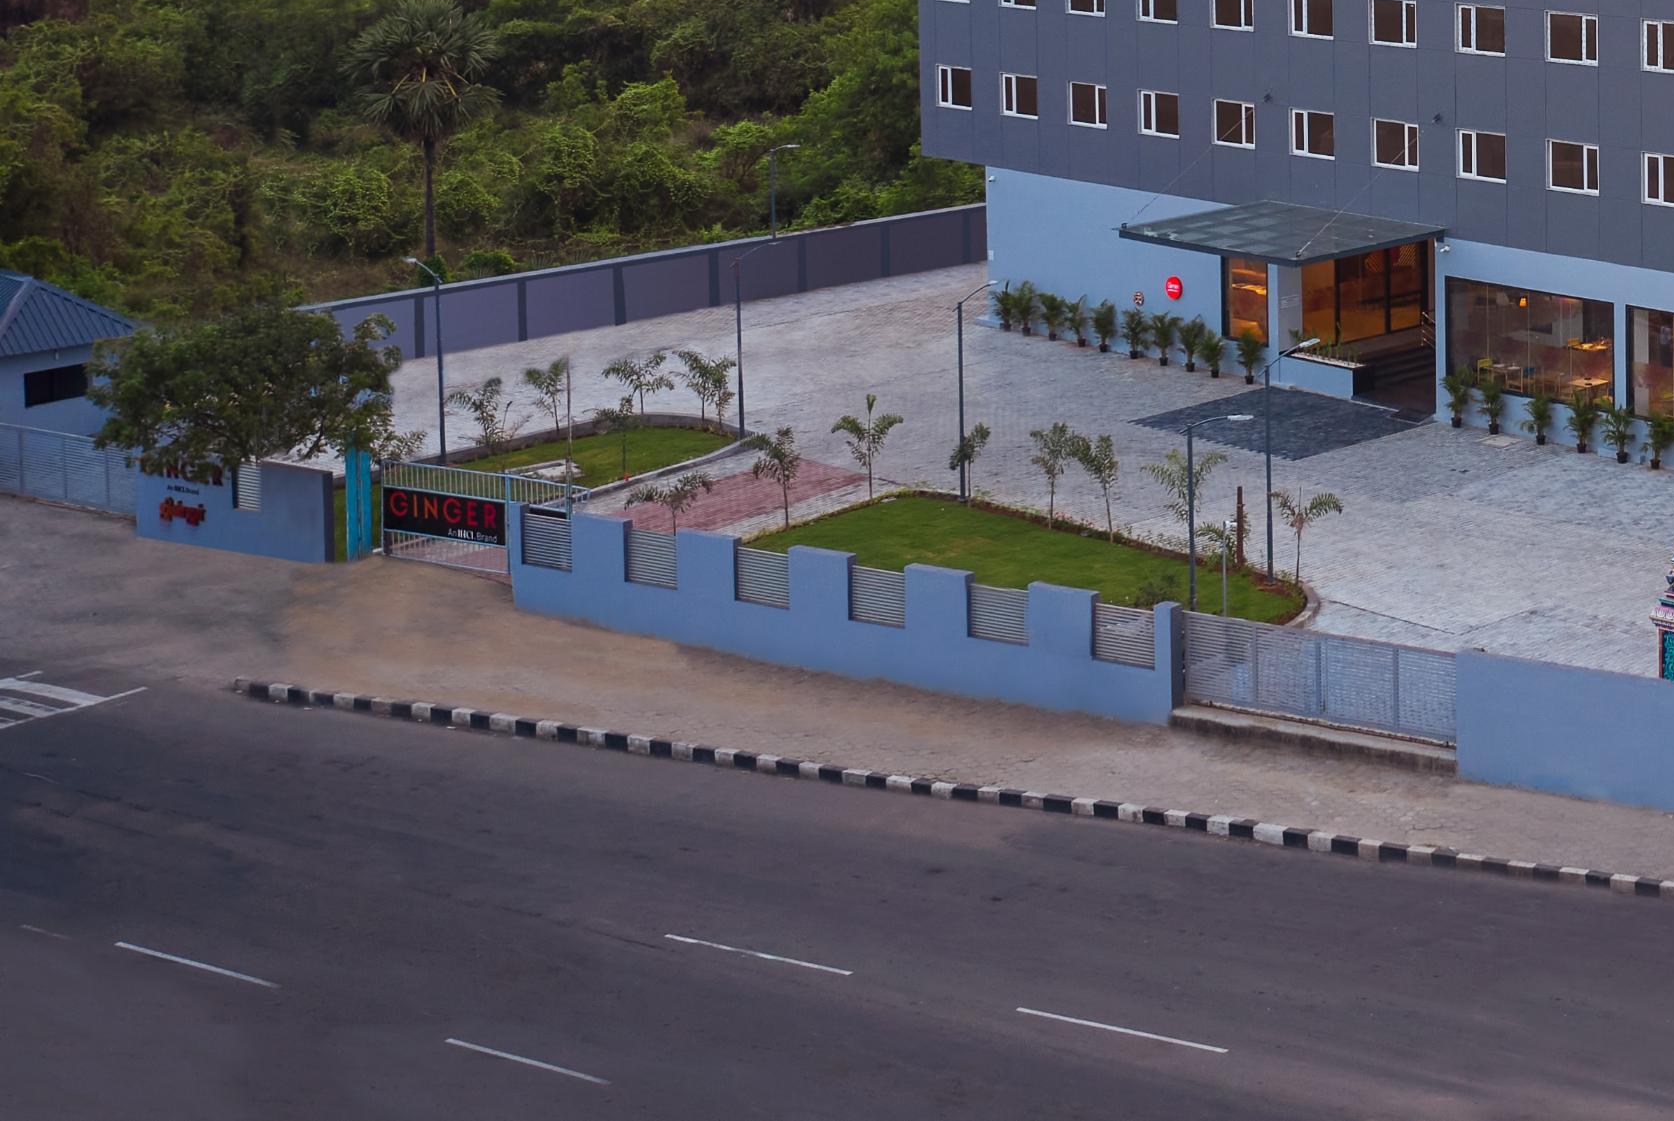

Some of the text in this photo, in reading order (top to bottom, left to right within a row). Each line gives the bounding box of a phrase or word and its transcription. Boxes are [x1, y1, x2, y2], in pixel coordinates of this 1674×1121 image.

[389, 490, 497, 529] GINGER
[447, 528, 457, 537] An
[476, 531, 498, 543] Brand
